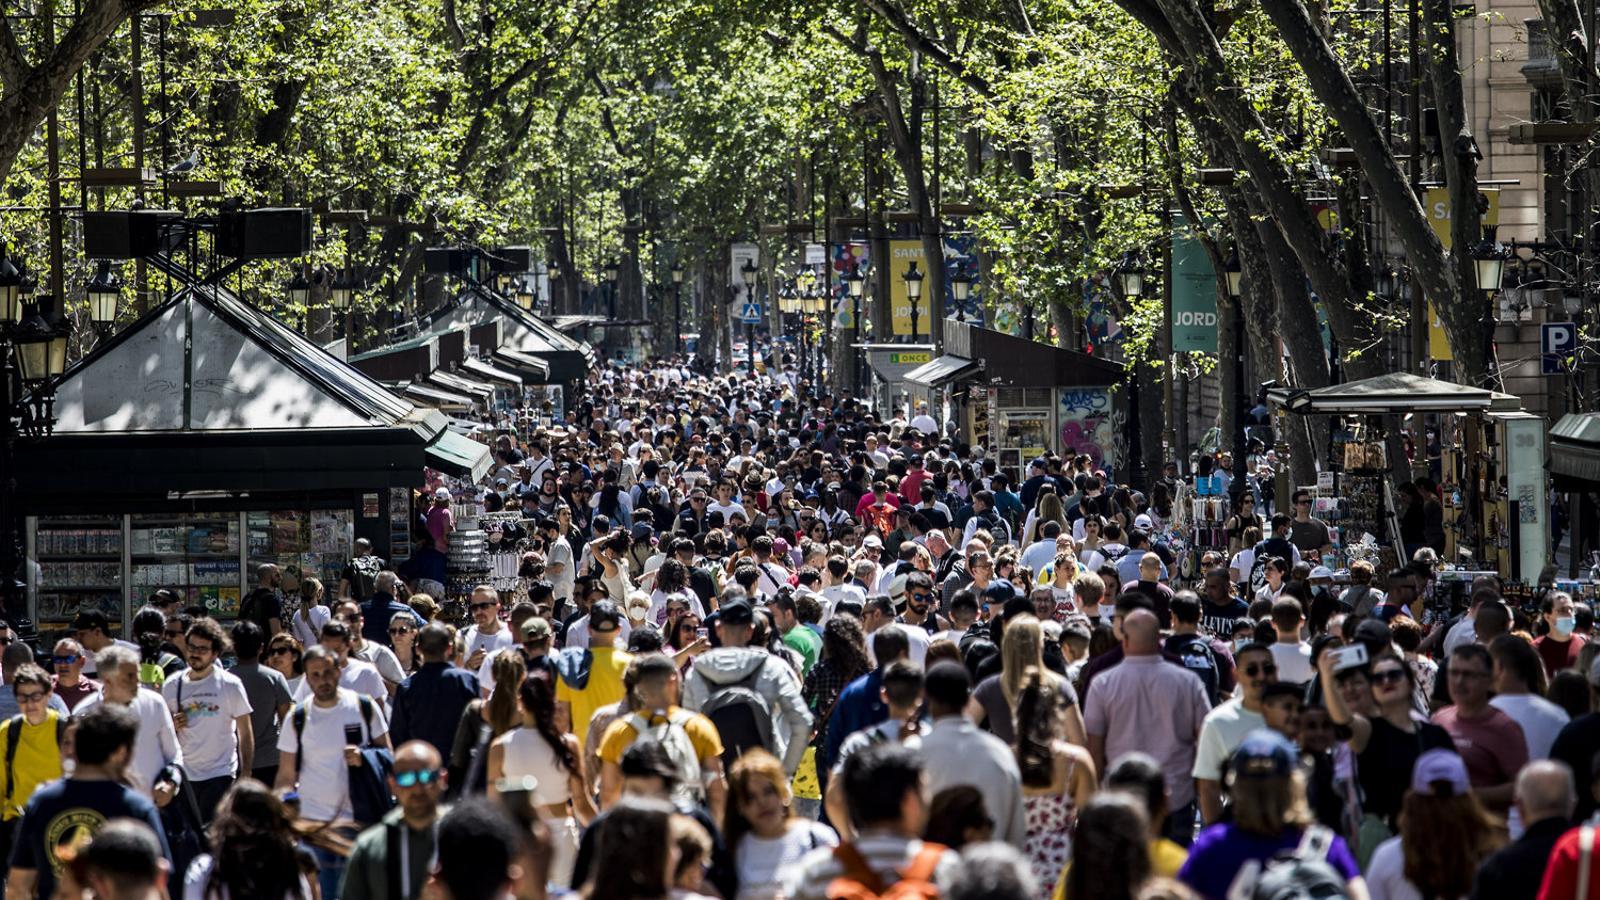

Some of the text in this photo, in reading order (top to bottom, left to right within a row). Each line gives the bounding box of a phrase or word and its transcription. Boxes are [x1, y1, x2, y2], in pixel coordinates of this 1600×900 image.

[894, 248, 924, 259] SANT
[1174, 311, 1217, 326] JORD
[1548, 327, 1569, 353] P
[1203, 615, 1235, 635] LEVI'S
